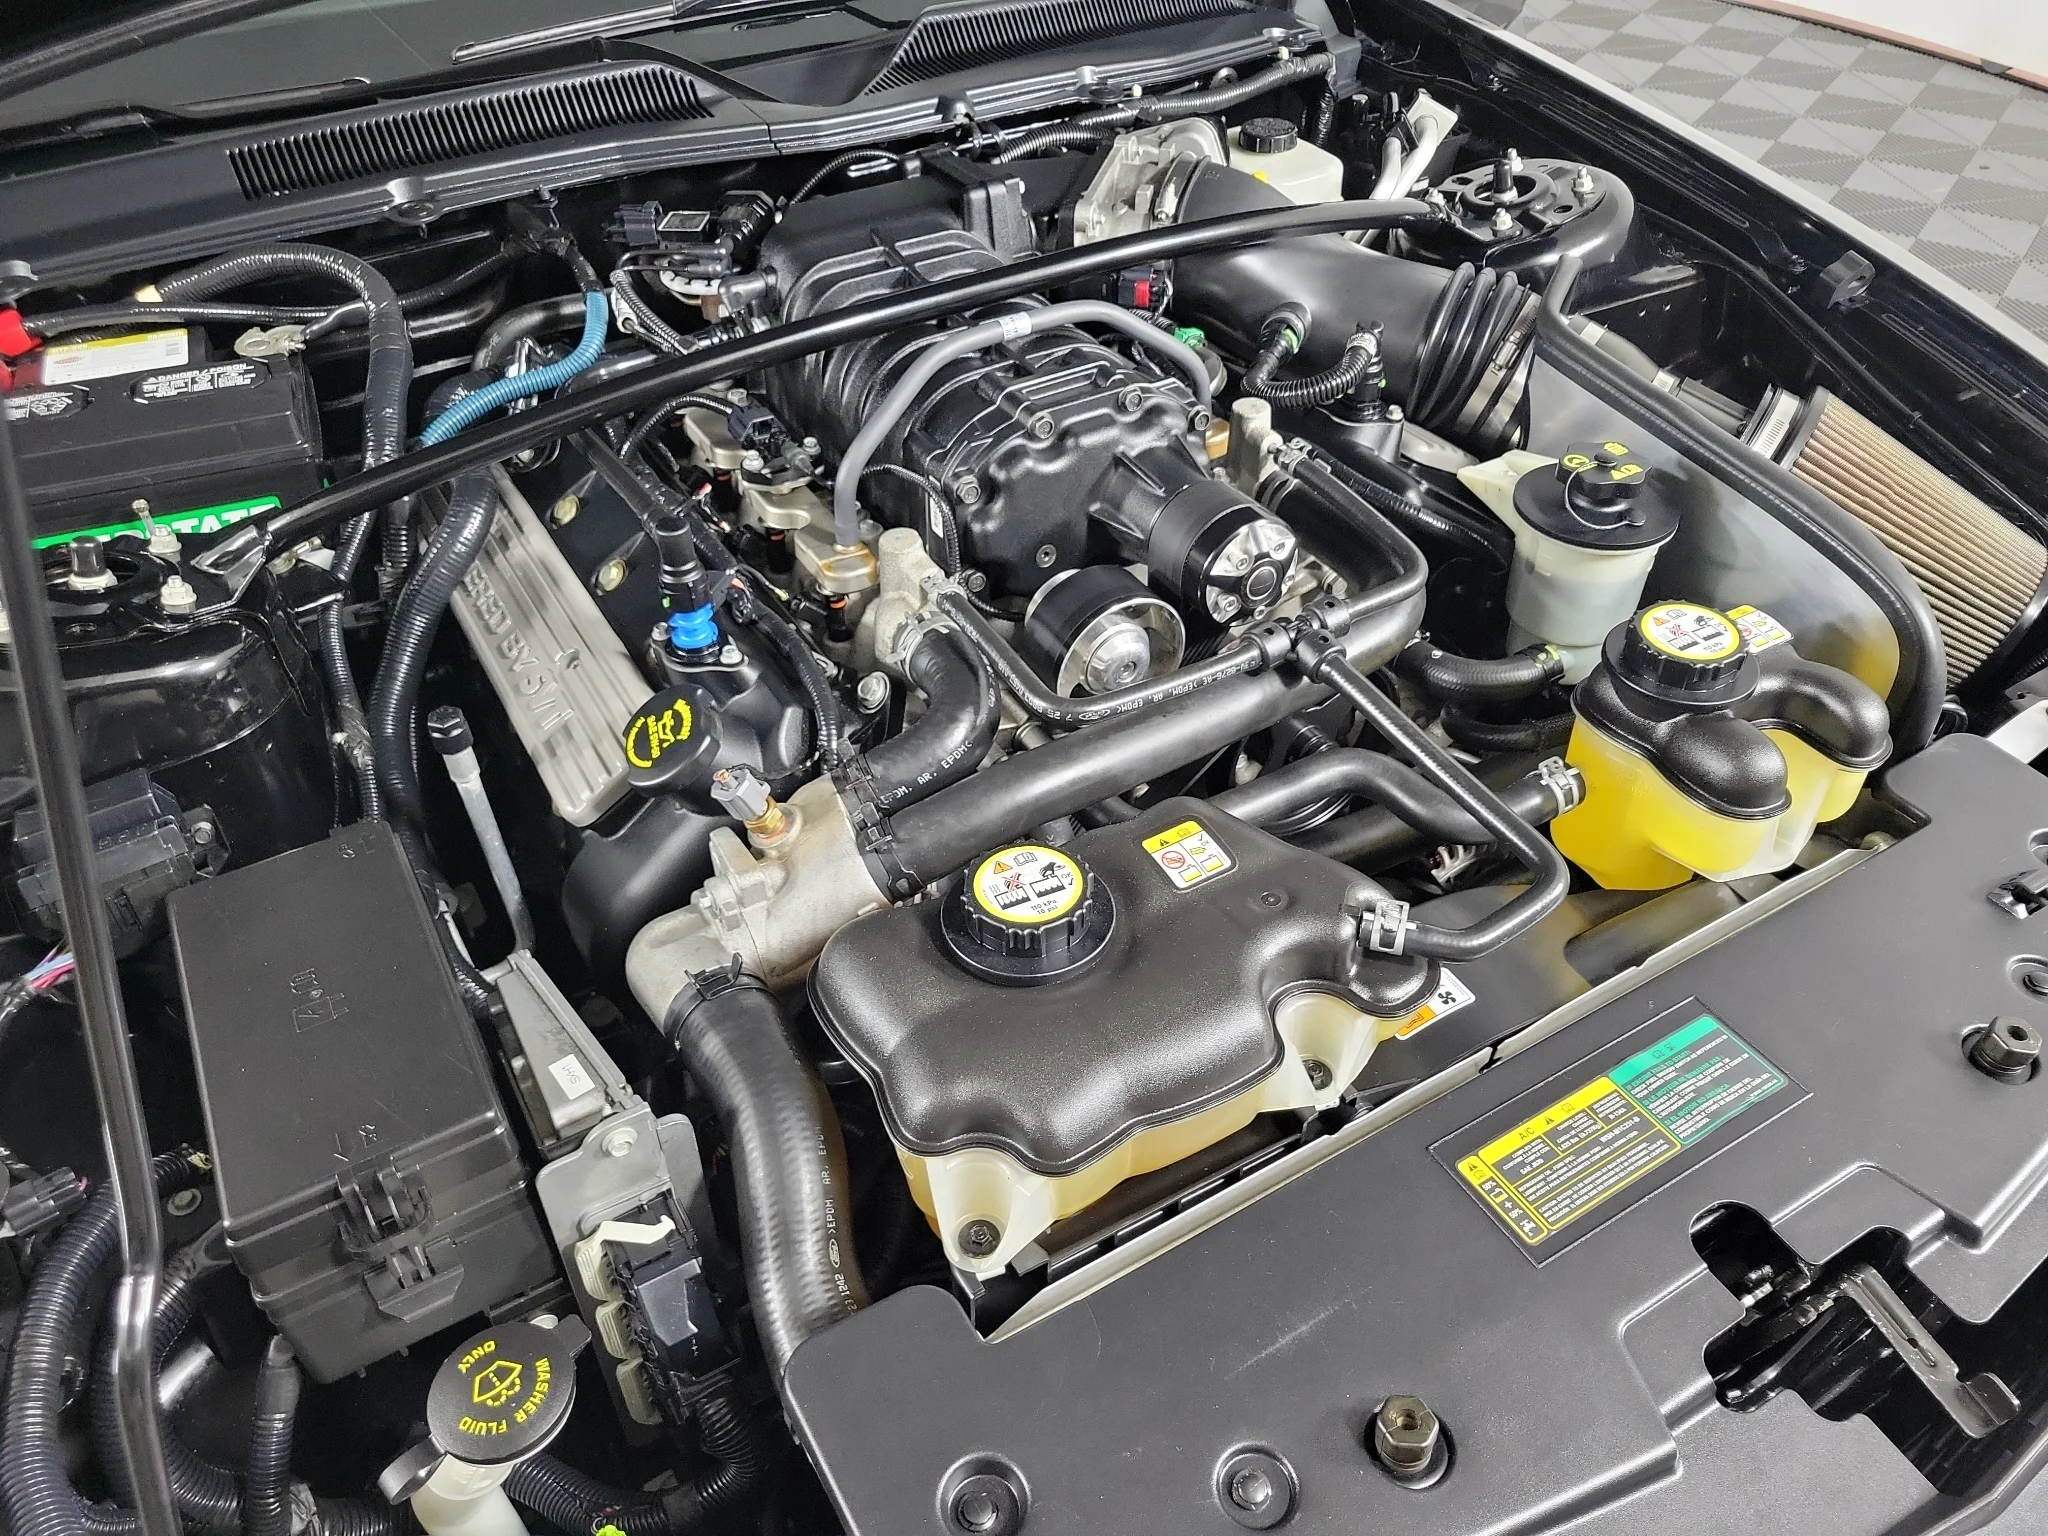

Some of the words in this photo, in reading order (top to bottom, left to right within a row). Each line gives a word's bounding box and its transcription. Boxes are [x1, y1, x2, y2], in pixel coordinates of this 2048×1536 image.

[209, 363, 248, 374] POISON
[500, 629, 539, 673] BY
[916, 771, 938, 786] AR,
[1030, 903, 1042, 911] 110
[1042, 899, 1057, 908] kPa
[1519, 1127, 1535, 1140] A/C
[821, 1164, 832, 1186] AR,
[1482, 1180, 1496, 1191] 50%
[1508, 1208, 1523, 1219] 50%
[834, 1273, 850, 1297] 1242
[457, 1340, 497, 1375] ONLY
[513, 1357, 552, 1424] WASHER
[458, 1415, 510, 1437] FLUID
